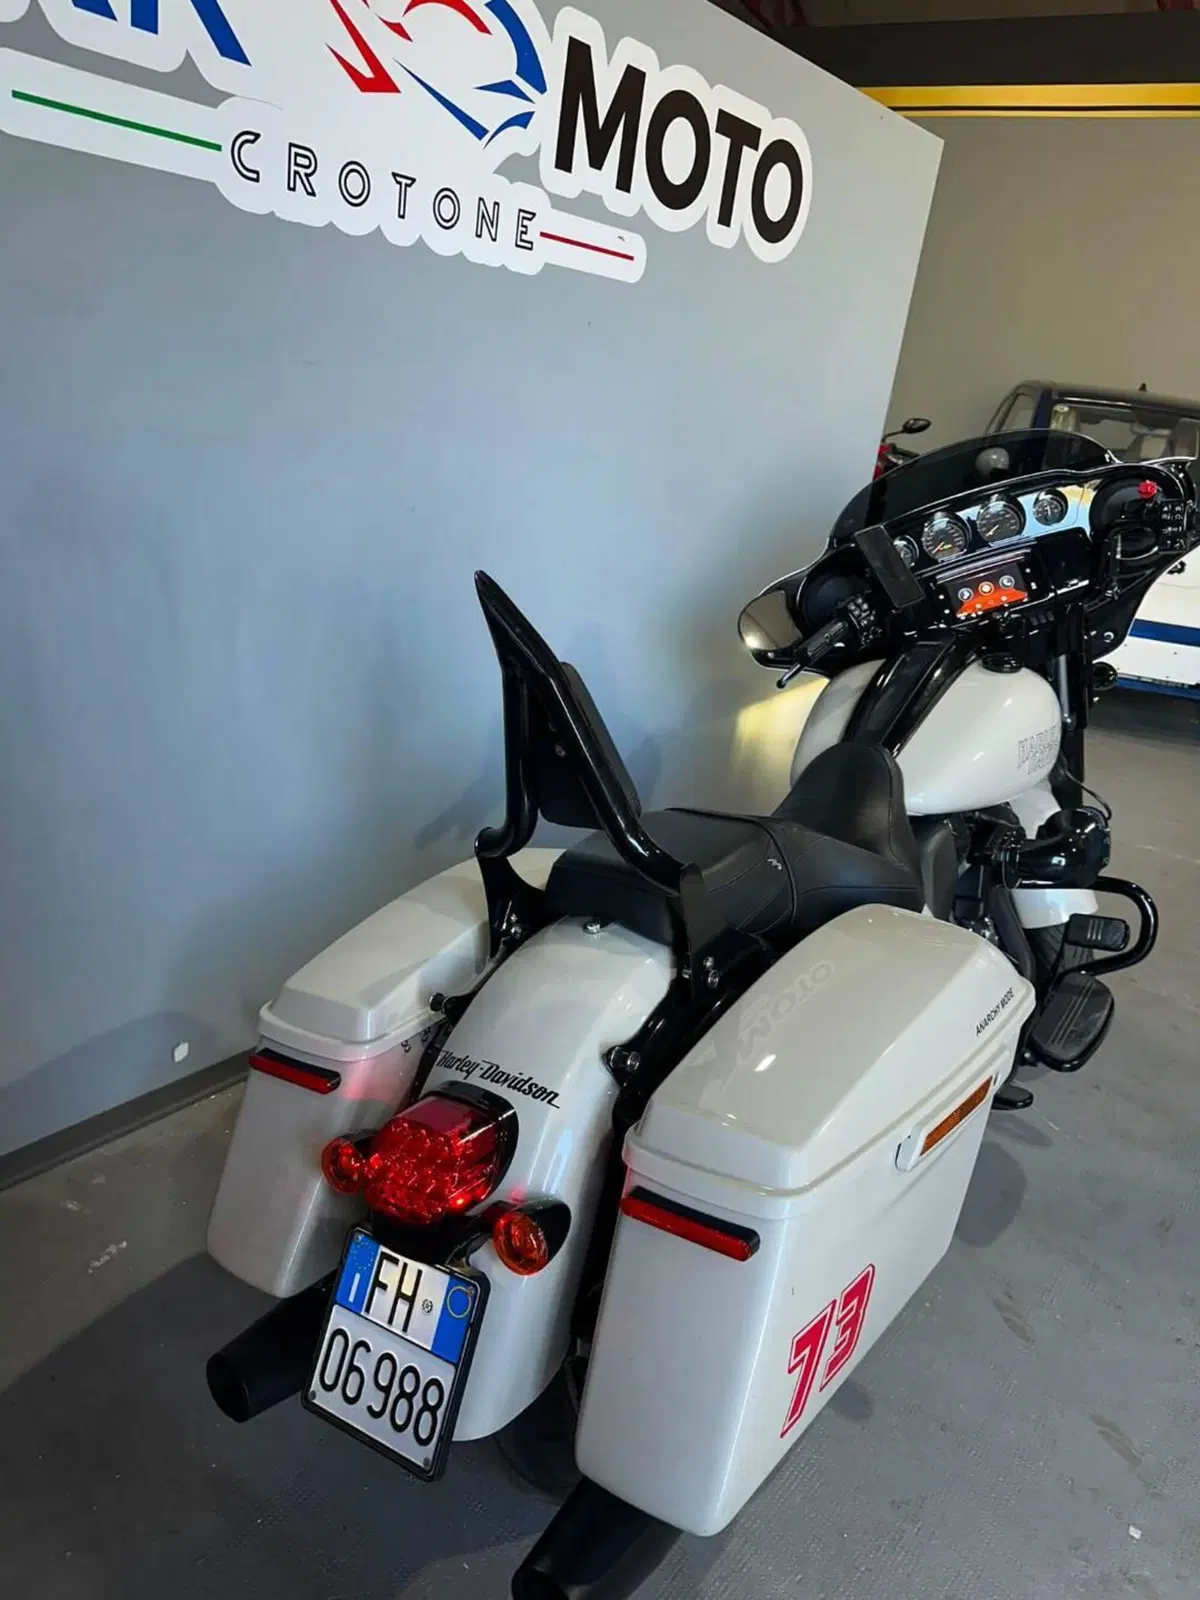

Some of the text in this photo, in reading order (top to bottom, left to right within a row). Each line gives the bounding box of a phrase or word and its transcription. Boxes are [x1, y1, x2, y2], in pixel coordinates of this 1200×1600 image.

[231, 131, 537, 250] CROTONE
[555, 36, 803, 244] MOTO
[437, 1050, 560, 1108] Harley-Davidson
[365, 1251, 423, 1333] FH
[780, 1263, 875, 1438] 73
[319, 1328, 444, 1446] 06988
